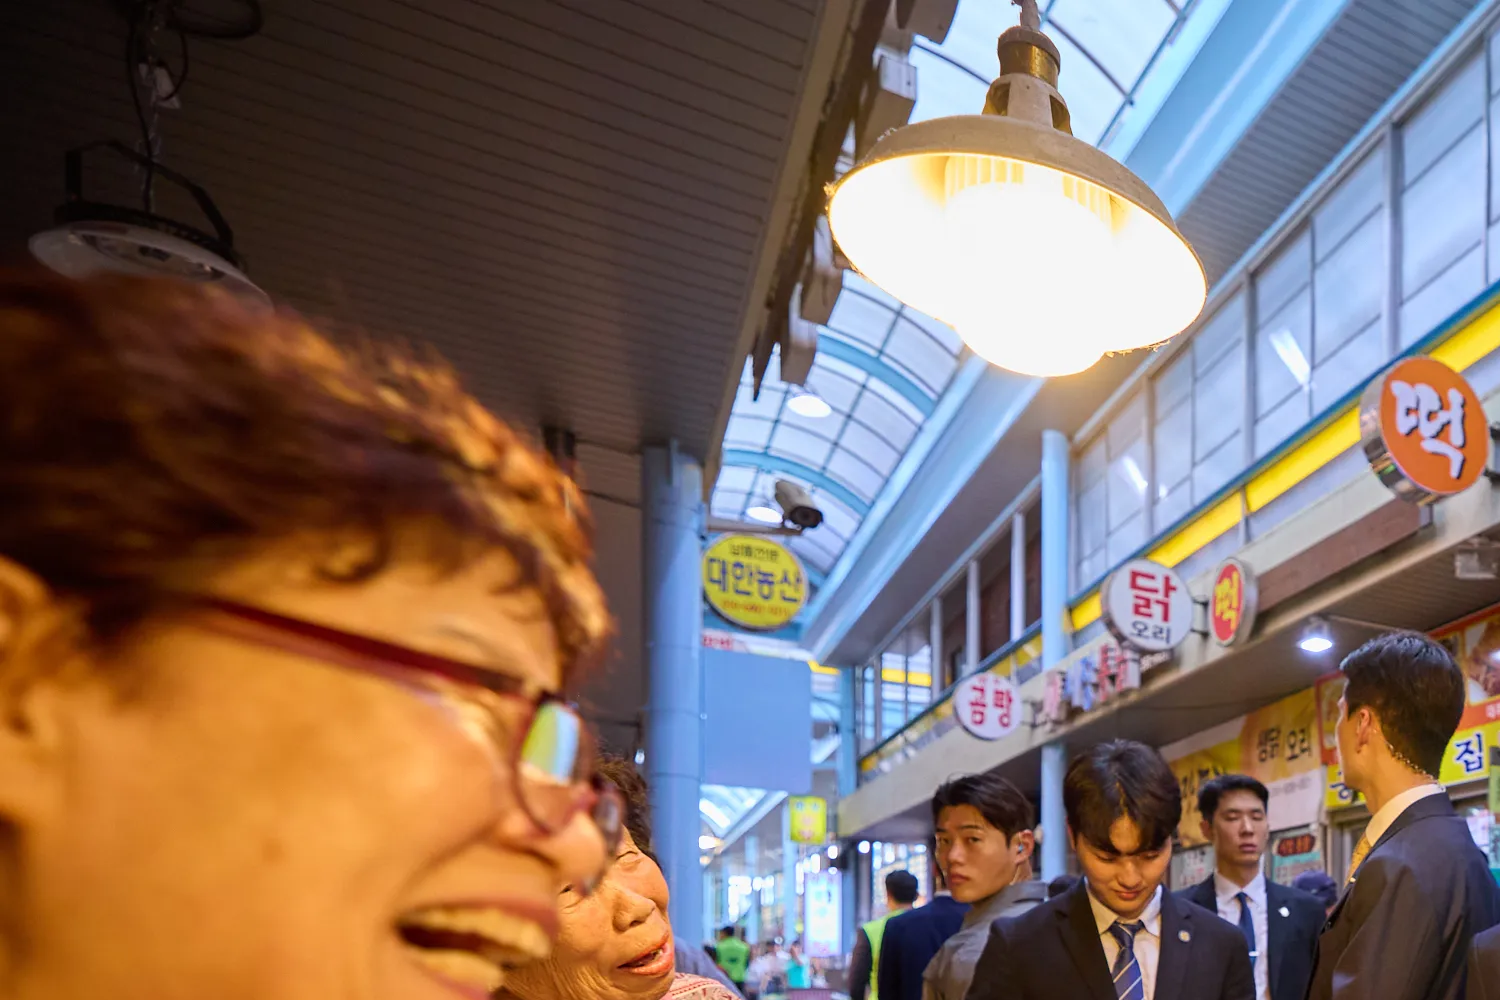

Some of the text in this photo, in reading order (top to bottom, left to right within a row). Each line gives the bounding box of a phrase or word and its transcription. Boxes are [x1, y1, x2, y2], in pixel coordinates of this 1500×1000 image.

[1390, 379, 1467, 481] 떡
[707, 557, 805, 603] 대한농산
[1129, 569, 1178, 623] 닭
[1129, 620, 1172, 645] 오리
[969, 684, 1014, 728] 곰탕
[1286, 726, 1313, 762] 오리
[1454, 732, 1484, 774] 집
